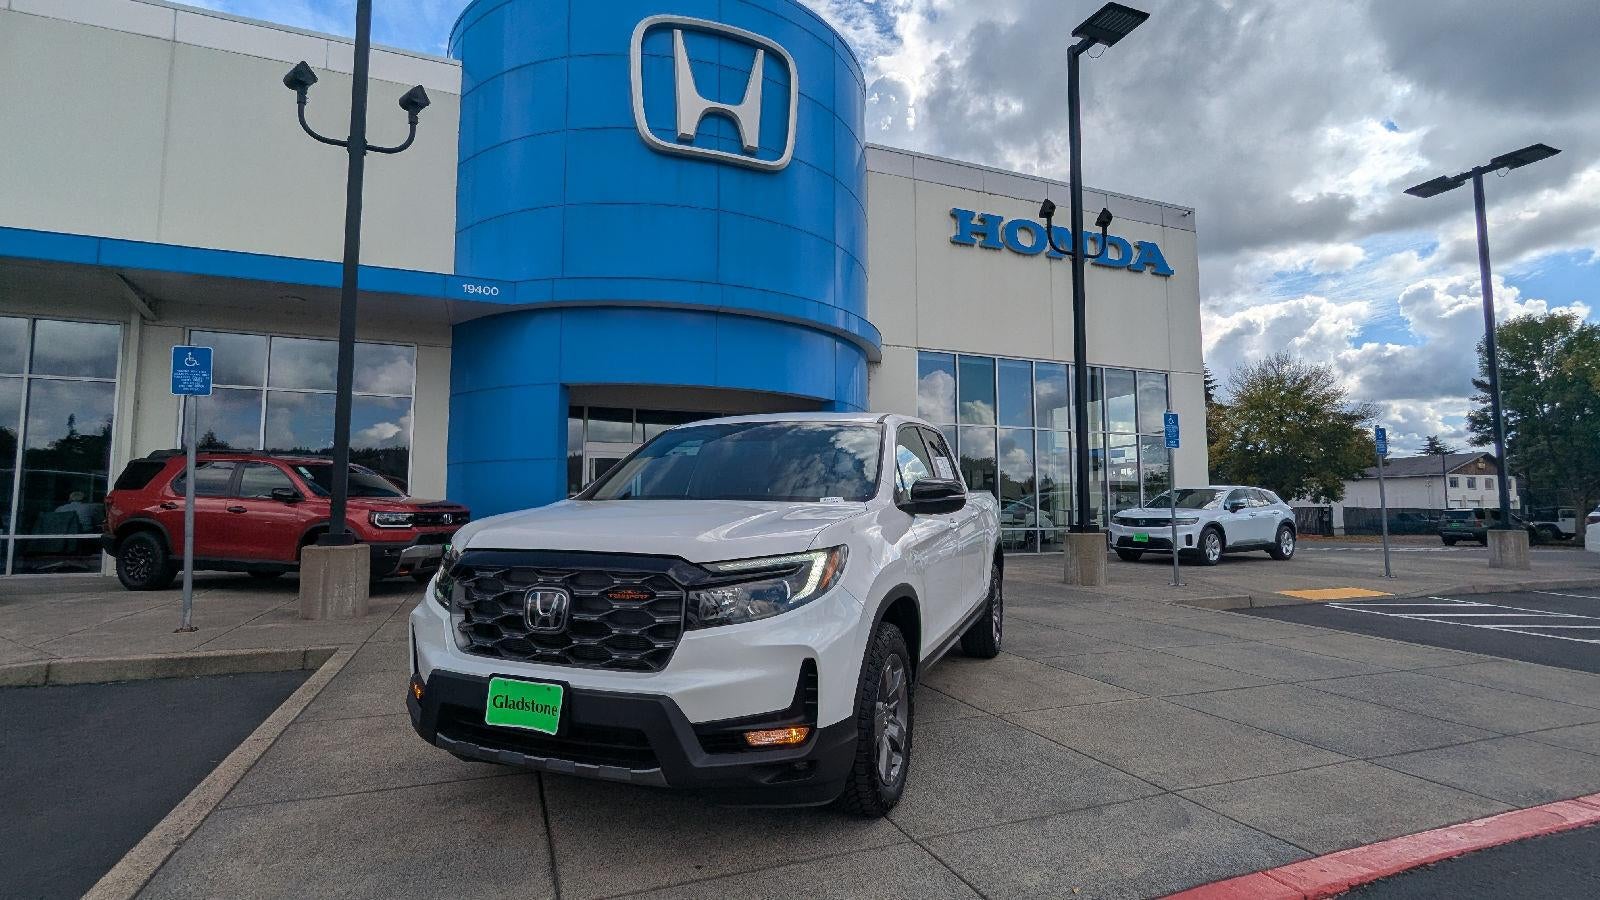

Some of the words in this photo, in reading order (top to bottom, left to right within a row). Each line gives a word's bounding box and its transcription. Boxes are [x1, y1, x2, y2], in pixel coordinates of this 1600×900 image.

[950, 206, 1175, 277] HONDA
[462, 283, 499, 296] 19400
[492, 694, 558, 717] Gladstone
